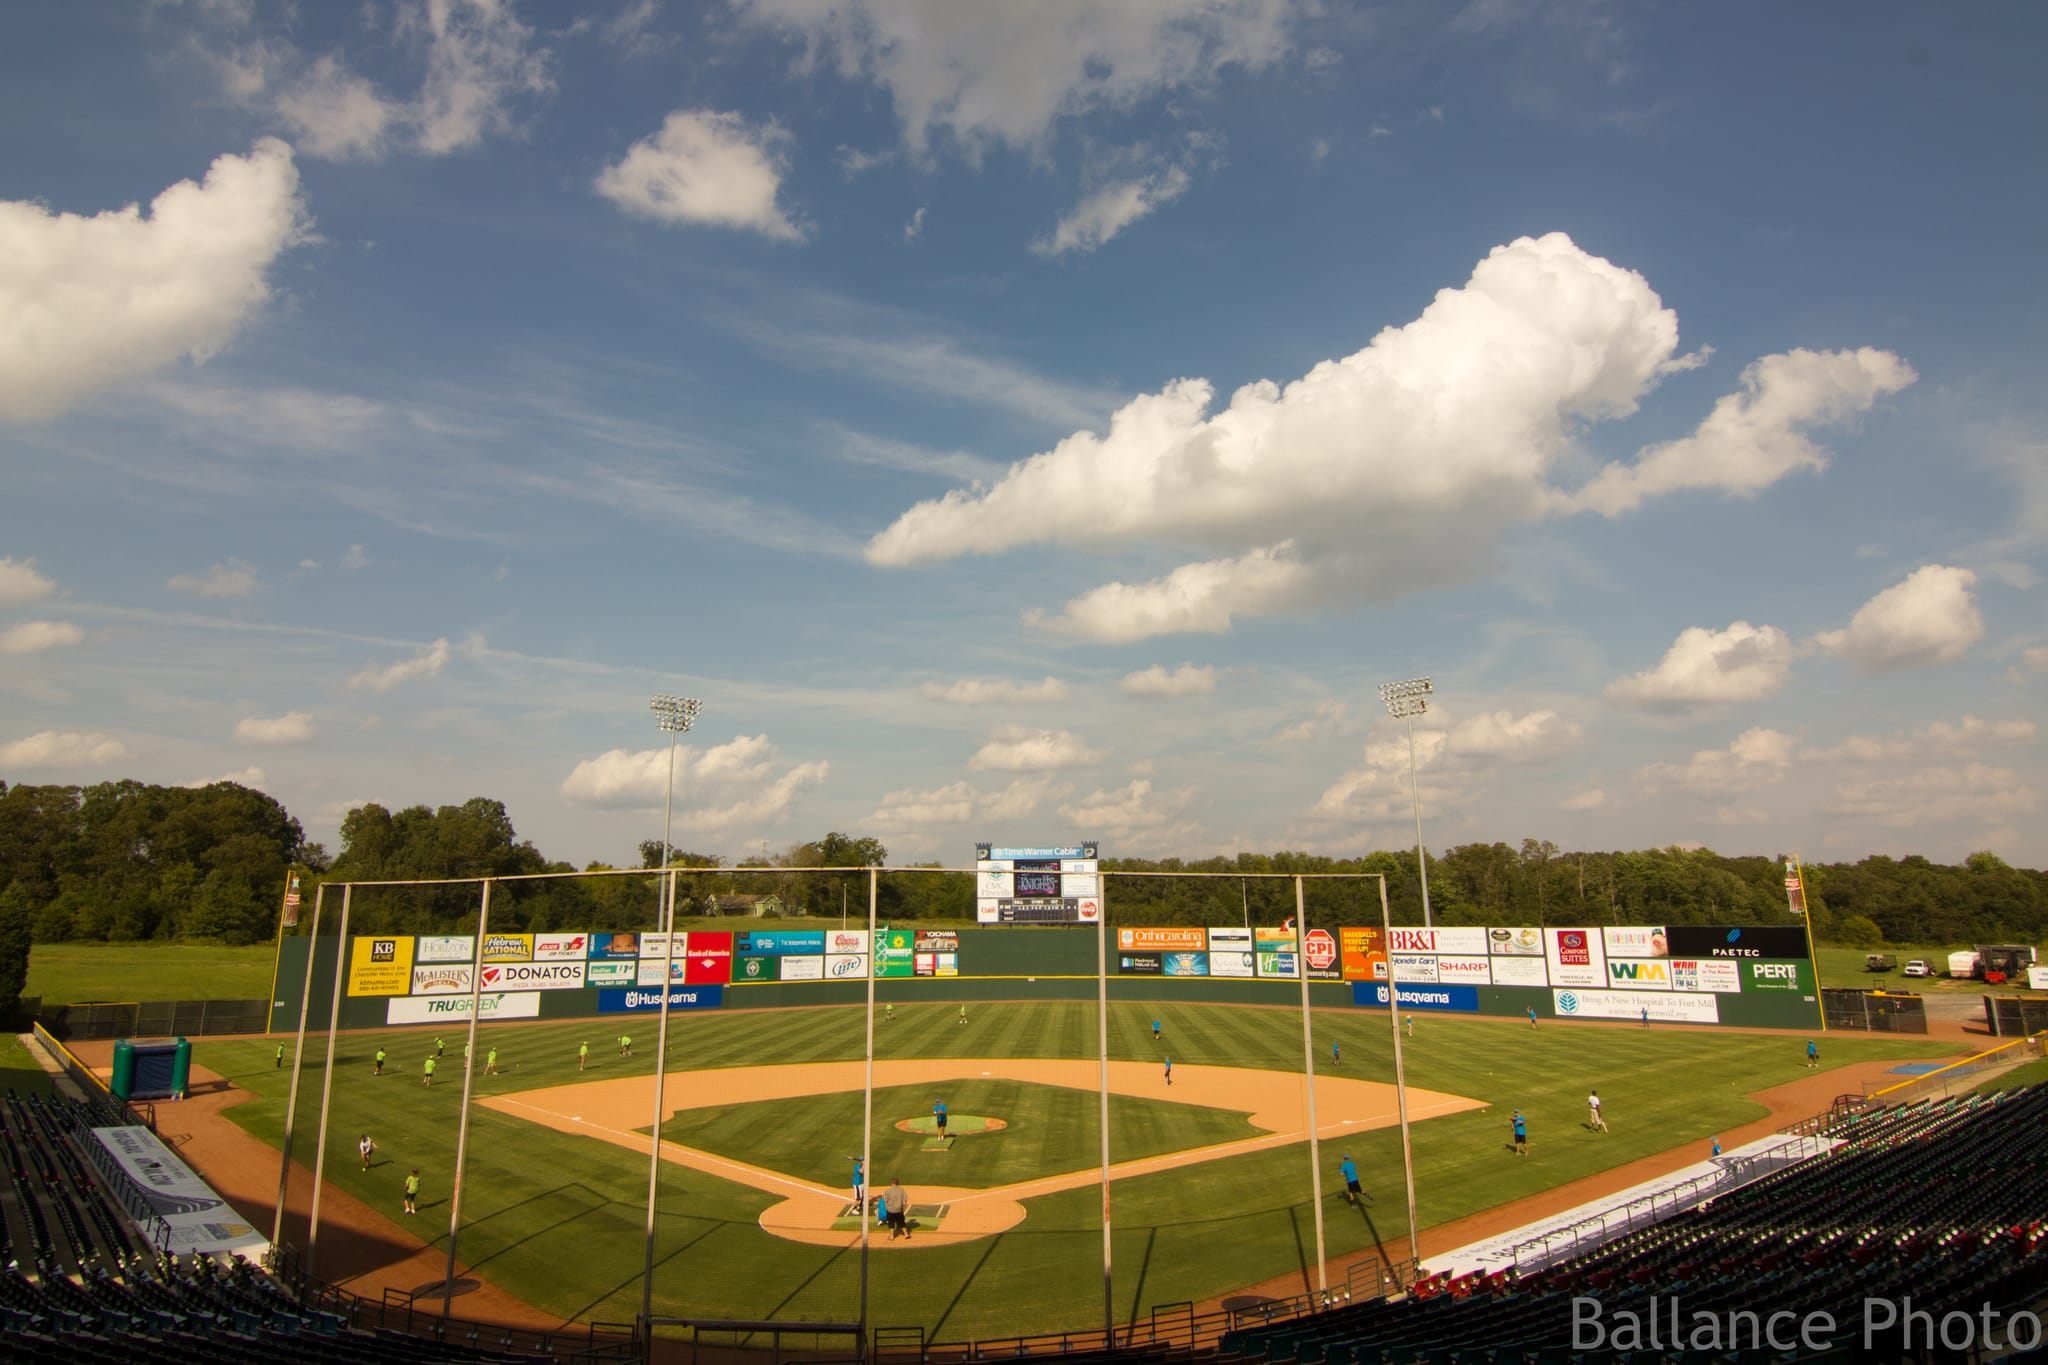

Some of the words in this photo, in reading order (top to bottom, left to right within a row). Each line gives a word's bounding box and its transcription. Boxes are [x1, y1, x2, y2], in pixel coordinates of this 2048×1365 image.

[1004, 848, 1025, 856] Time
[1025, 848, 1053, 856] Warner
[1054, 847, 1078, 856] Cable
[1135, 930, 1202, 941] OrthoCarolina
[1389, 930, 1439, 951] BB&T
[488, 936, 523, 947] Hebrew
[373, 942, 394, 954] KB
[424, 941, 469, 954] HORIZON
[708, 949, 730, 957] America
[1306, 942, 1333, 955] CPI
[1712, 948, 1760, 957] PAETEC
[1391, 957, 1418, 966] Honda
[1418, 957, 1435, 965] Cars
[1561, 955, 1588, 963] SUITES
[1439, 962, 1488, 972] SHARP
[1673, 961, 1697, 969] WRHI
[505, 966, 582, 981] DONATOS
[1610, 963, 1665, 980] WM
[1753, 964, 1796, 979] PERT
[1675, 979, 1684, 987] FM
[1612, 996, 1630, 1004] New
[1632, 996, 1664, 1007] Hospital
[1667, 998, 1677, 1006] To
[1678, 998, 1695, 1006] Fort
[1698, 998, 1714, 1008] Mill
